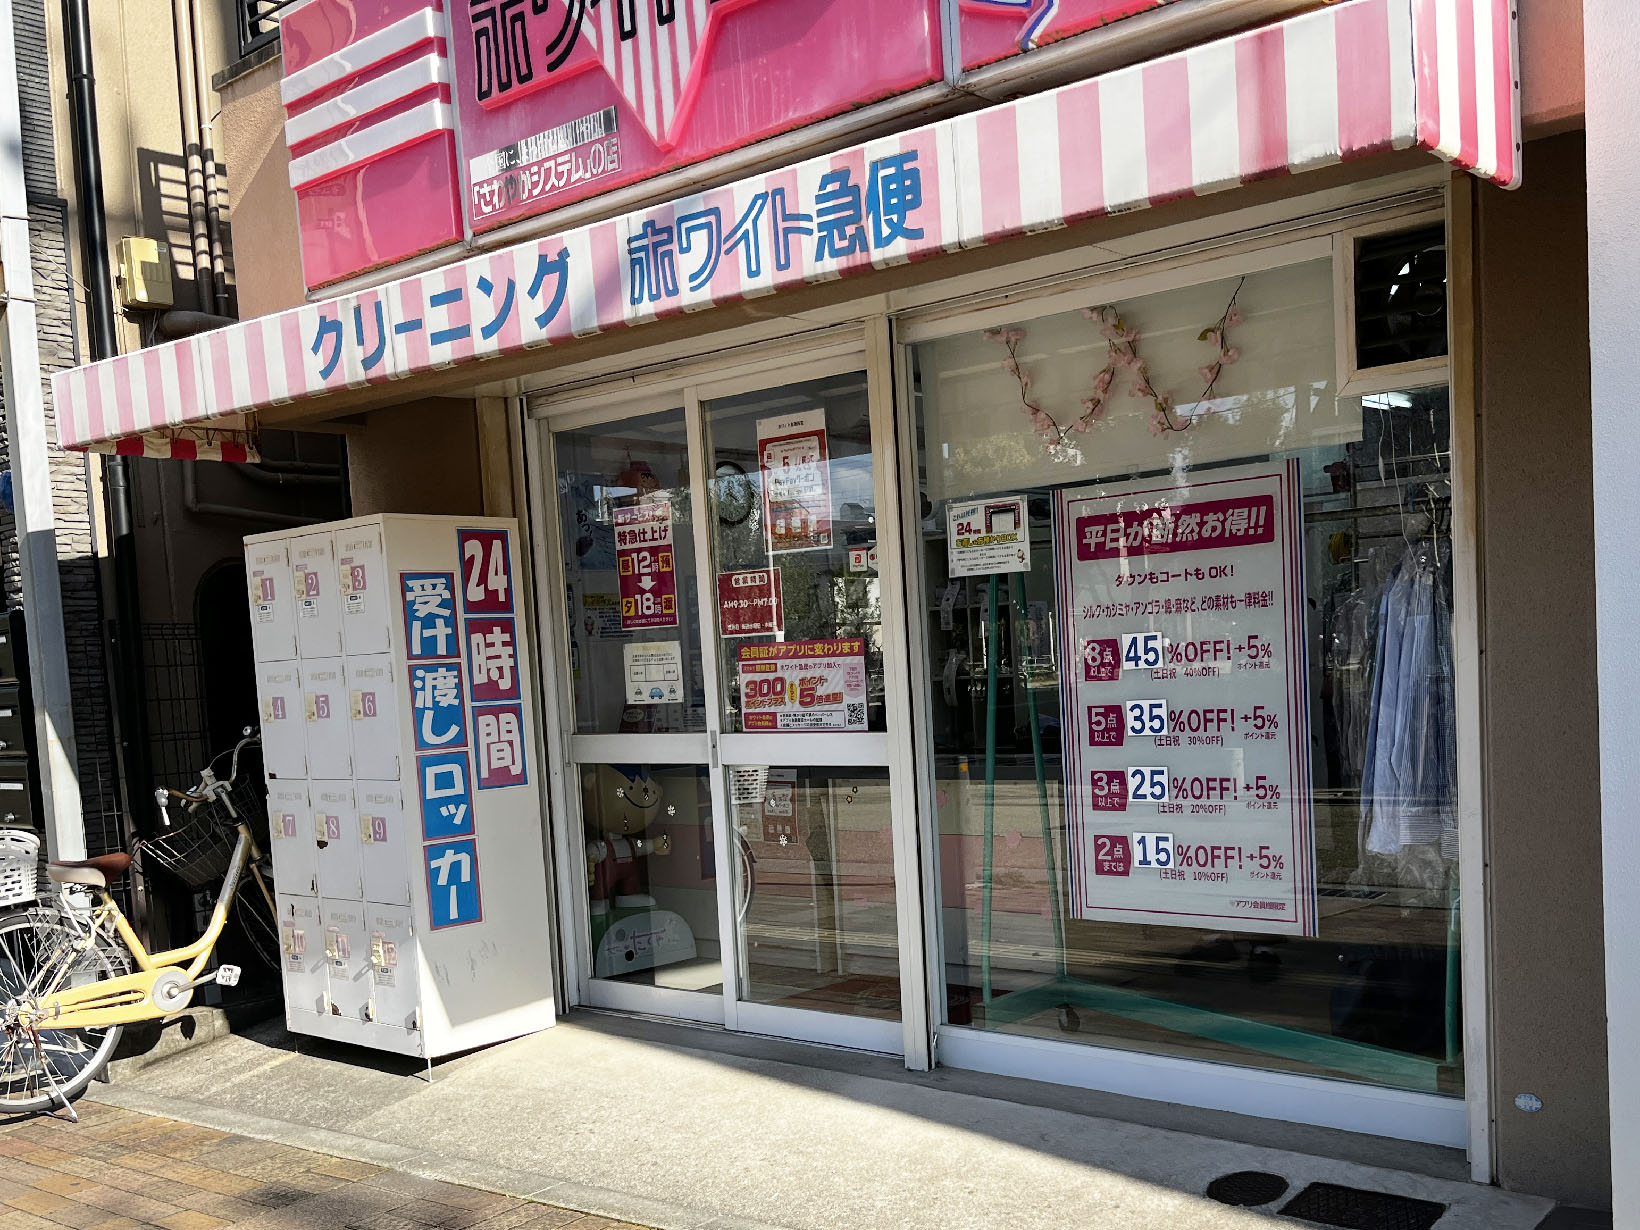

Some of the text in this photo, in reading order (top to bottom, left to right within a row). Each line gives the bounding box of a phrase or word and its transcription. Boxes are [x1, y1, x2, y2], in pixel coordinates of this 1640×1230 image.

[311, 150, 924, 381] クリーニング ホワイト急便
[617, 525, 669, 546] 特急仕上げ
[308, 574, 317, 595] 2
[354, 567, 363, 589] 3
[266, 579, 272, 600] 1
[740, 641, 861, 659] 会員証がアプリに変わります
[1124, 634, 1160, 668] 45
[744, 676, 787, 700] 300
[275, 698, 283, 718] 4
[319, 697, 327, 718] 5
[365, 695, 374, 716] 6
[1128, 702, 1165, 734] 35
[406, 577, 472, 921] 受け渡しロッカー
[1130, 768, 1166, 801] 25
[285, 816, 293, 835] 7
[329, 816, 338, 838] 8
[375, 818, 384, 839] 9
[1136, 835, 1171, 867] 15
